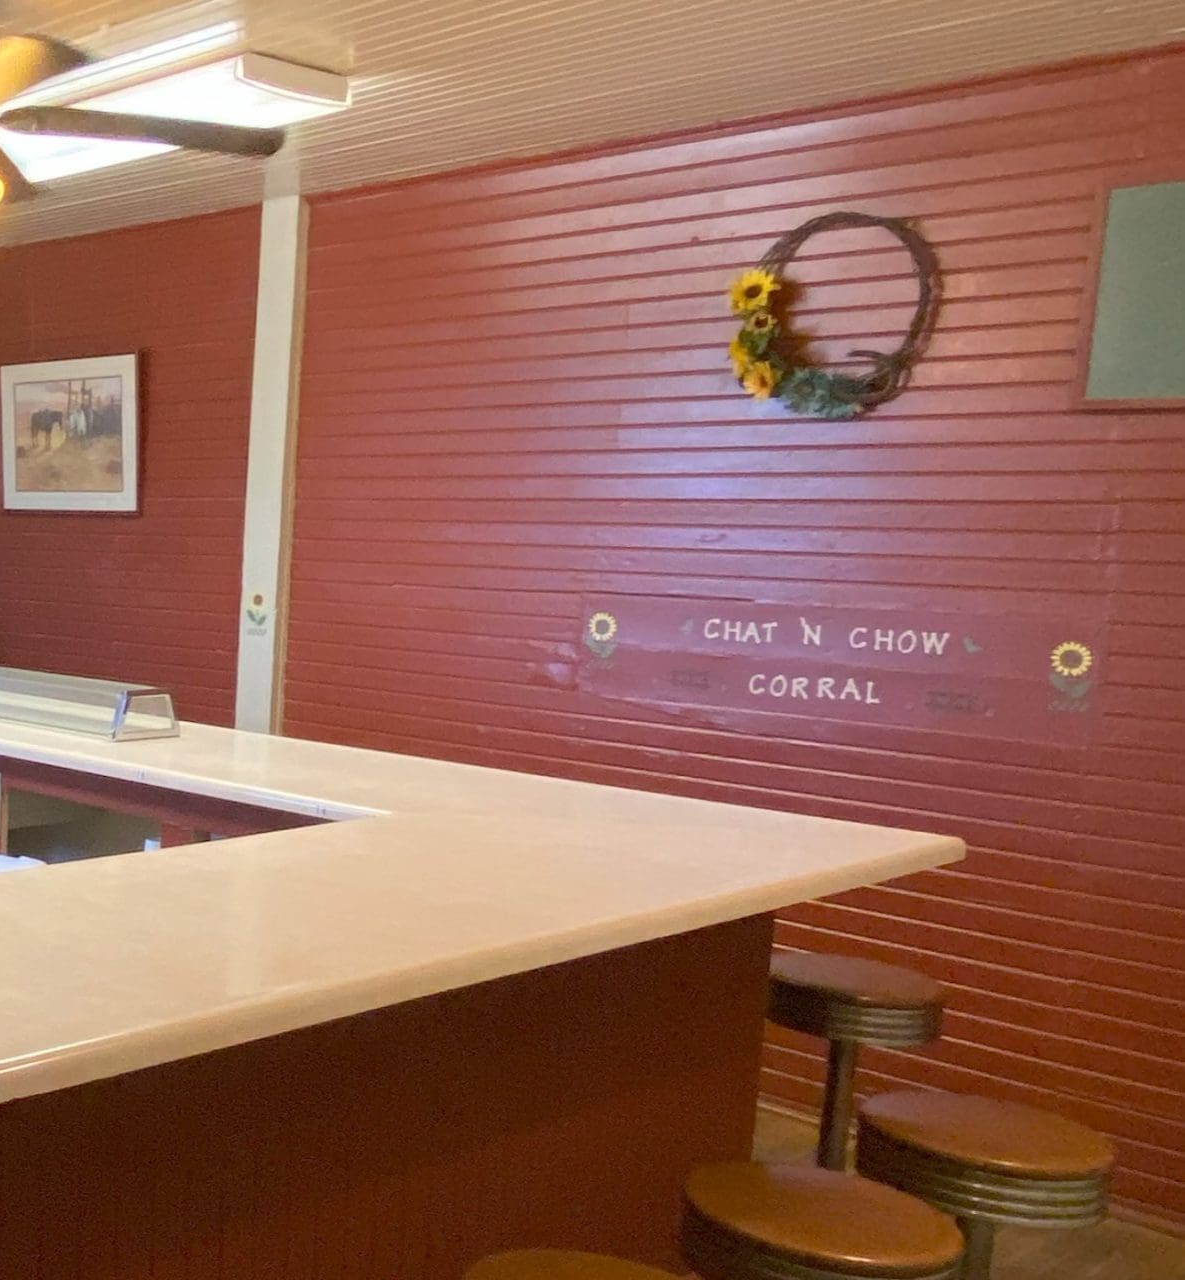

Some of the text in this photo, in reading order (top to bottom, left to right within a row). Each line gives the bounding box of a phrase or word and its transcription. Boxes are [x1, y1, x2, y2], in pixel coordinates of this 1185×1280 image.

[703, 618, 778, 643] CHAT
[849, 627, 950, 655] CHOW
[748, 674, 880, 704] CORRAL
